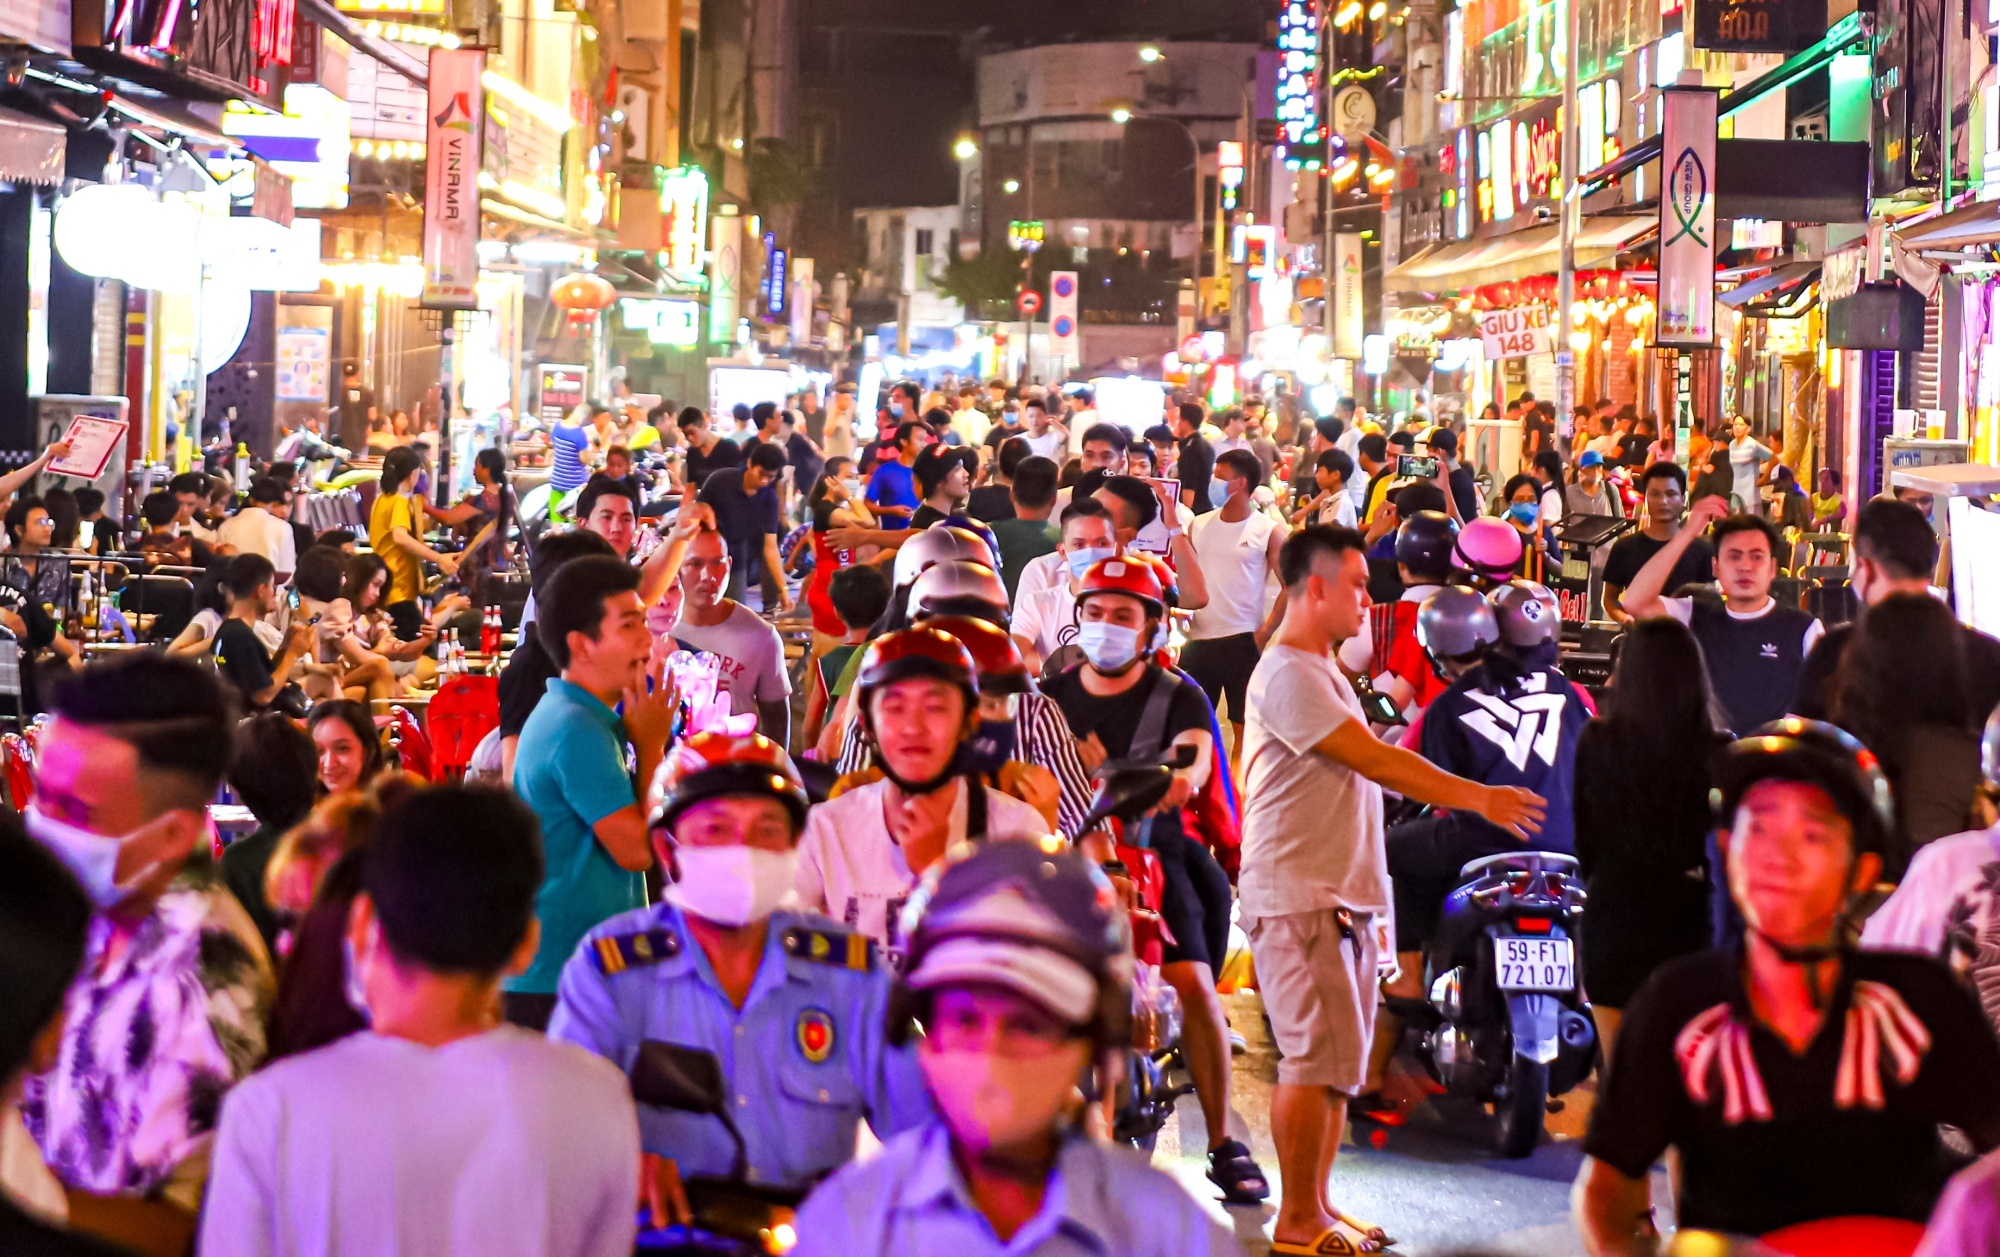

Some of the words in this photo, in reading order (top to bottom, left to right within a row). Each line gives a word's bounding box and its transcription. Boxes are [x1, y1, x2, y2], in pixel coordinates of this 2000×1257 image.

[446, 137, 463, 220] VINAMA
[1684, 160, 1693, 182] NEW
[1684, 183, 1692, 214] GROUP
[1522, 308, 1547, 331] XE
[1498, 332, 1535, 355] 148
[1507, 941, 1558, 963] 59-F1
[1501, 963, 1567, 986] 721.07
